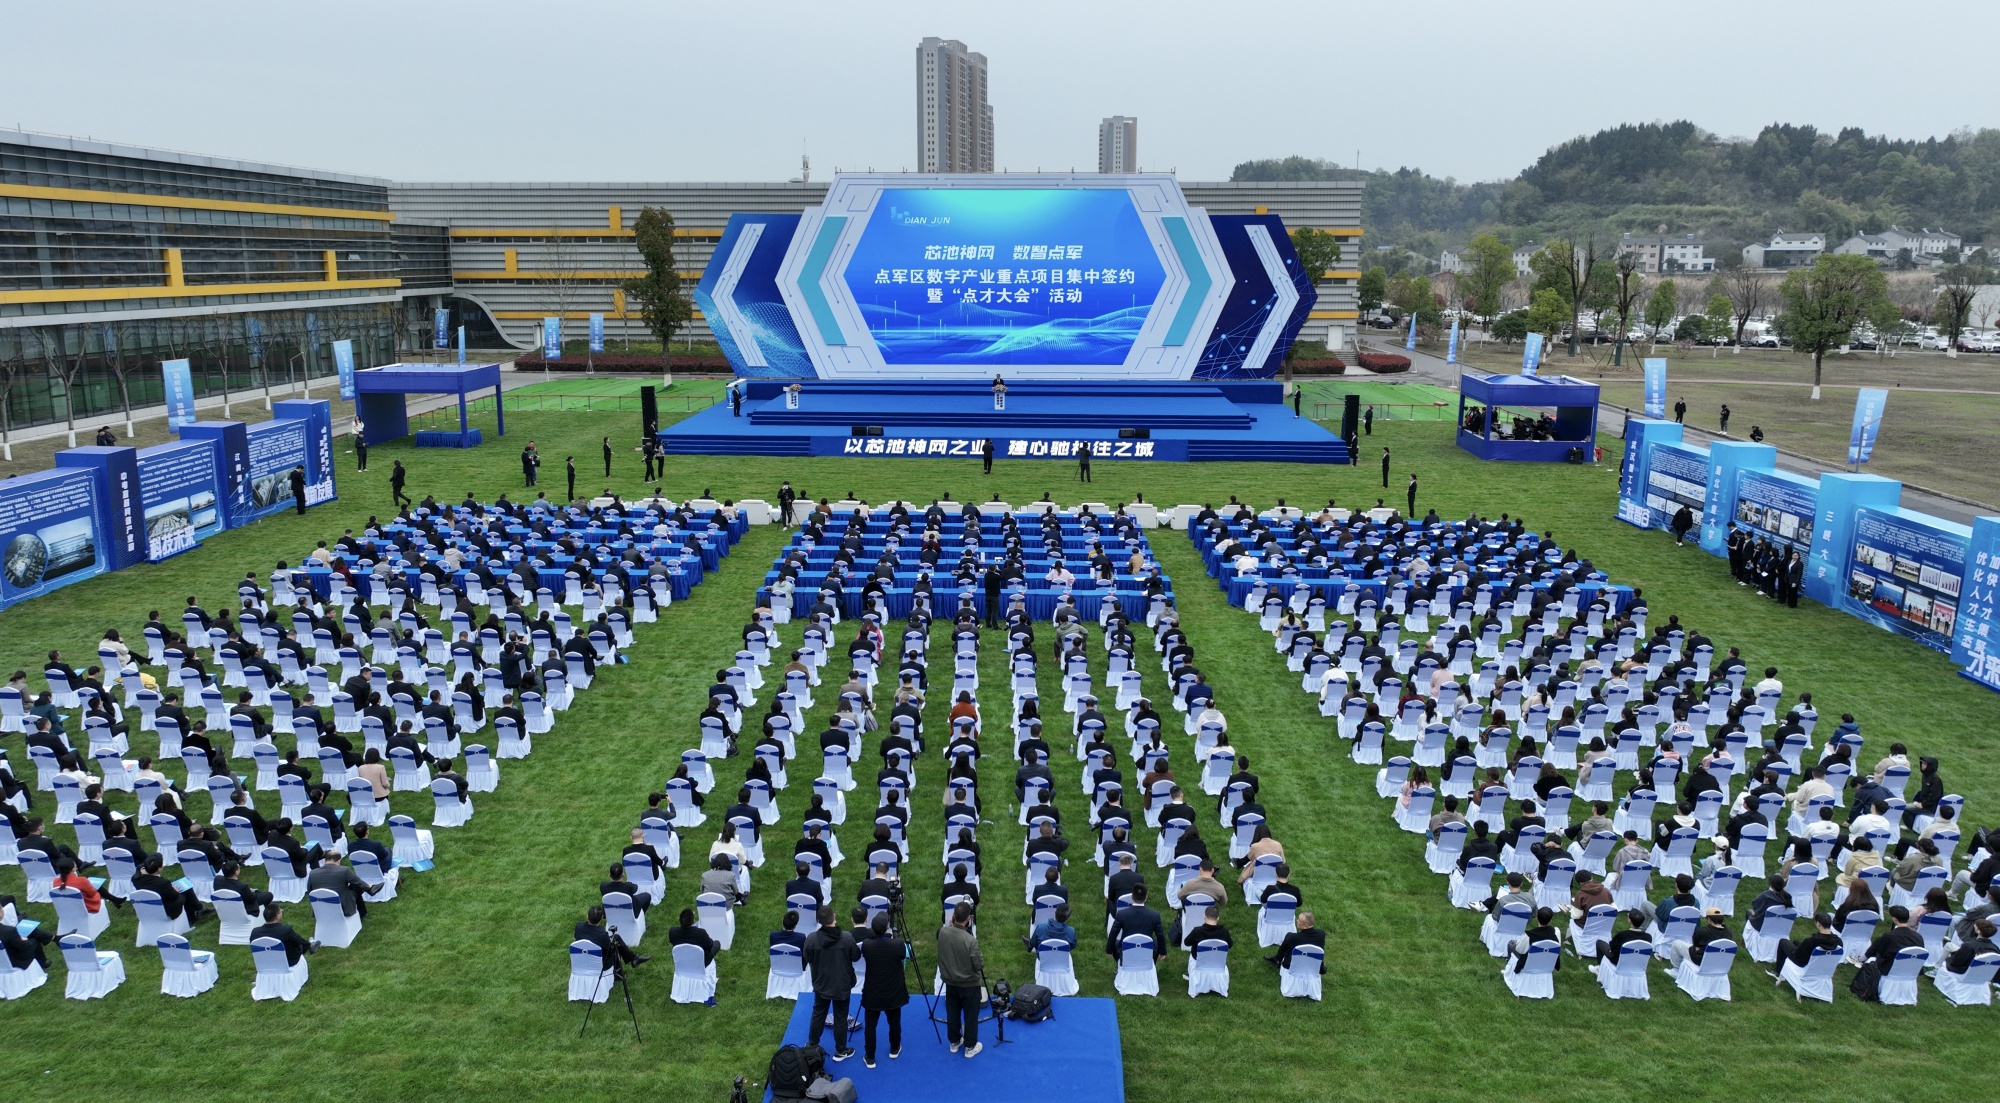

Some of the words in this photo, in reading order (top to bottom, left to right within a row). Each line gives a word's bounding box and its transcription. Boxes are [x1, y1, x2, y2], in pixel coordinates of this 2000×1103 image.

[904, 216, 927, 224] DIAN
[931, 216, 951, 224] JUN
[924, 244, 995, 261] 芯池神网
[1013, 244, 1083, 261] 数智点军
[874, 269, 1136, 285] 点军区数字产业重点项目集中签约
[844, 438, 985, 455] 以芯池神网之业
[1708, 465, 1722, 540] 湖北工业大学
[149, 524, 196, 560] 科技未来
[1818, 510, 1834, 579] 三峡大学
[1961, 550, 1989, 650] 优化人才生态
[1974, 554, 2000, 653] 加快人才集聚
